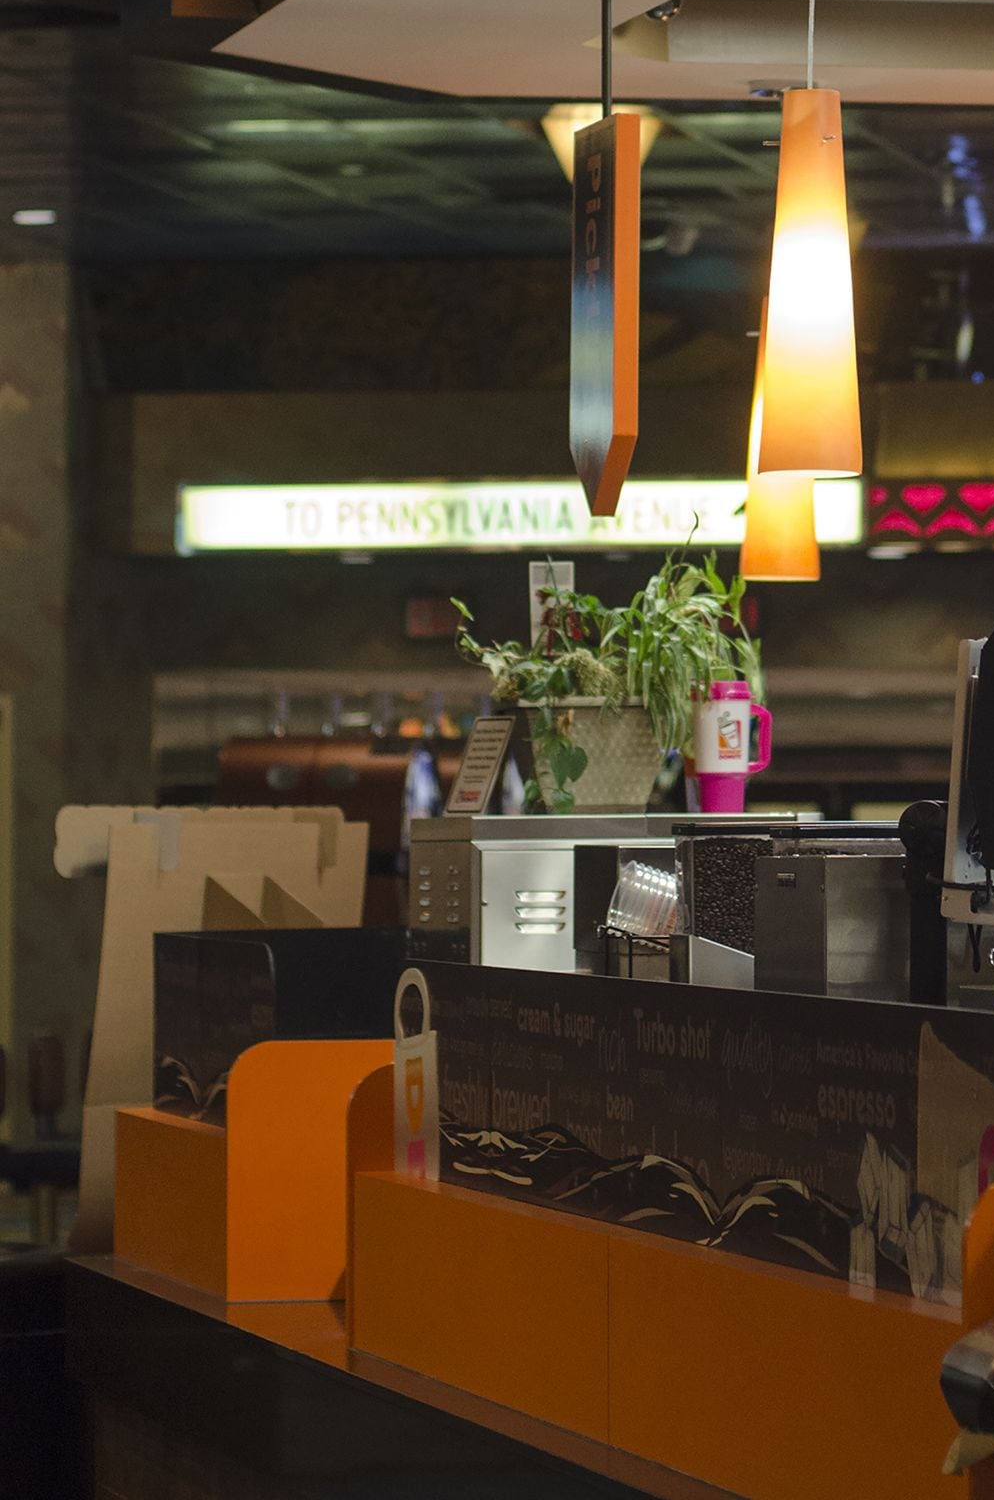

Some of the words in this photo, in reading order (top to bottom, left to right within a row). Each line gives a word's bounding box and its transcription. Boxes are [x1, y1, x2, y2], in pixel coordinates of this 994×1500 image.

[283, 499, 322, 536] TO
[337, 496, 573, 537] PENNSYLVANIA
[517, 1006, 551, 1034] cream
[553, 1002, 562, 1037] &
[564, 1012, 596, 1047] sugar
[633, 1008, 676, 1055] Turbo
[491, 1070, 551, 1132] brewed
[606, 1084, 635, 1122] bean
[817, 1083, 896, 1133] espresso
